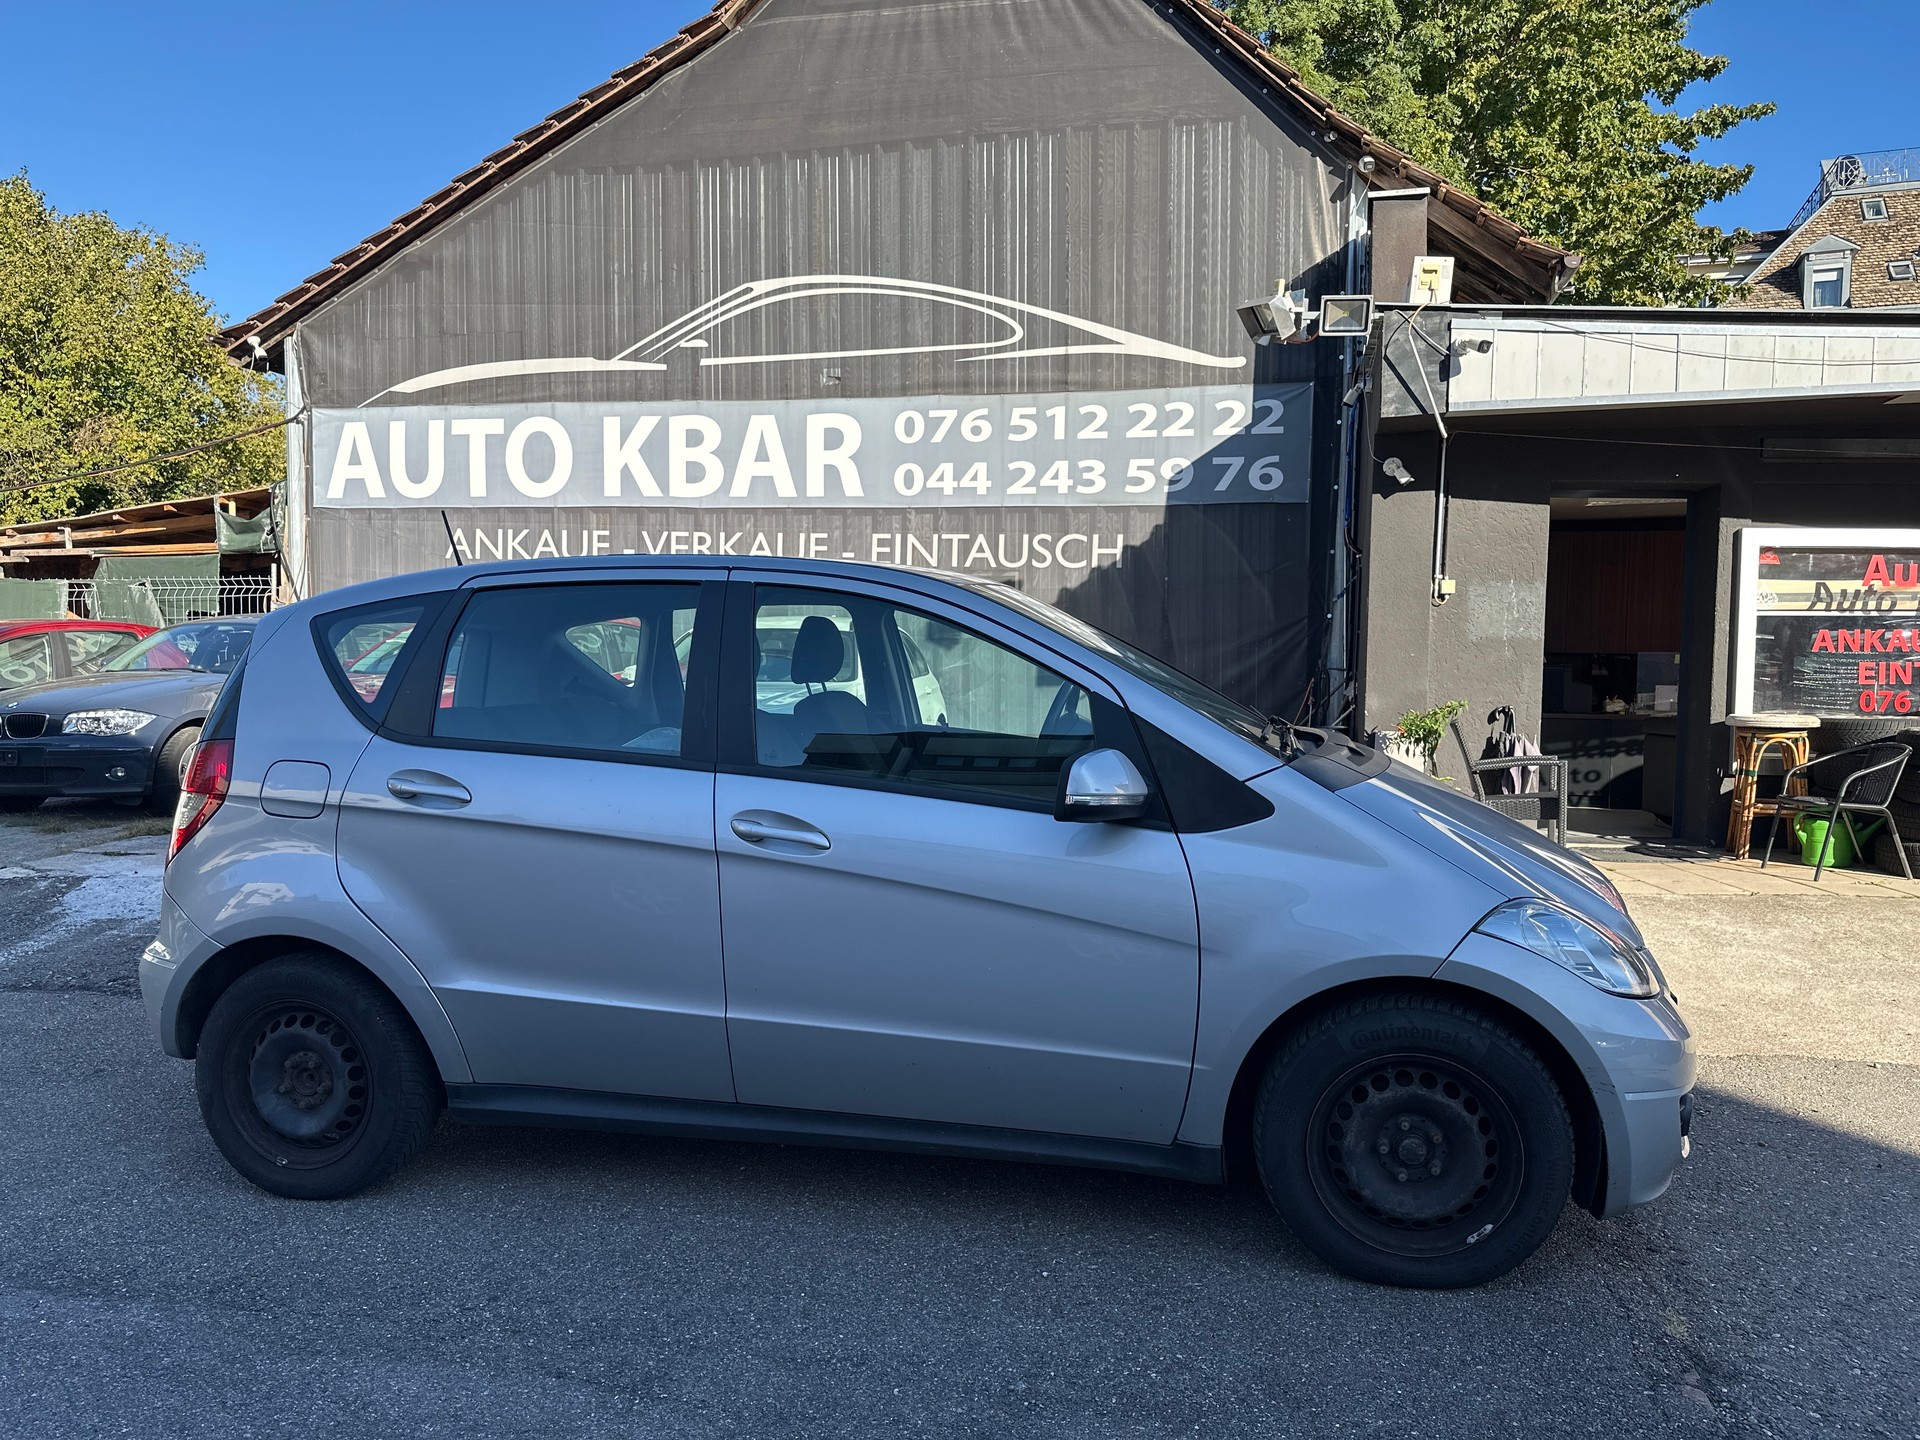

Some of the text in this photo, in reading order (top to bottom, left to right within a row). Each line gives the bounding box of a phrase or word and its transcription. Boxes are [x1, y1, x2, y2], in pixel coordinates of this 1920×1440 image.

[894, 399, 1285, 444] 076 512 22 22
[326, 412, 865, 499] AUTO KBAR
[893, 455, 1285, 497] 044 243 59 76
[445, 528, 610, 560] ANKAUF
[871, 533, 1124, 568] EINTAUSCH
[1862, 554, 1919, 587] Au
[1807, 582, 1898, 616] Auto
[1858, 661, 1920, 685] EIN
[1859, 690, 1912, 713] 076
[1351, 1023, 1458, 1049] Continental
